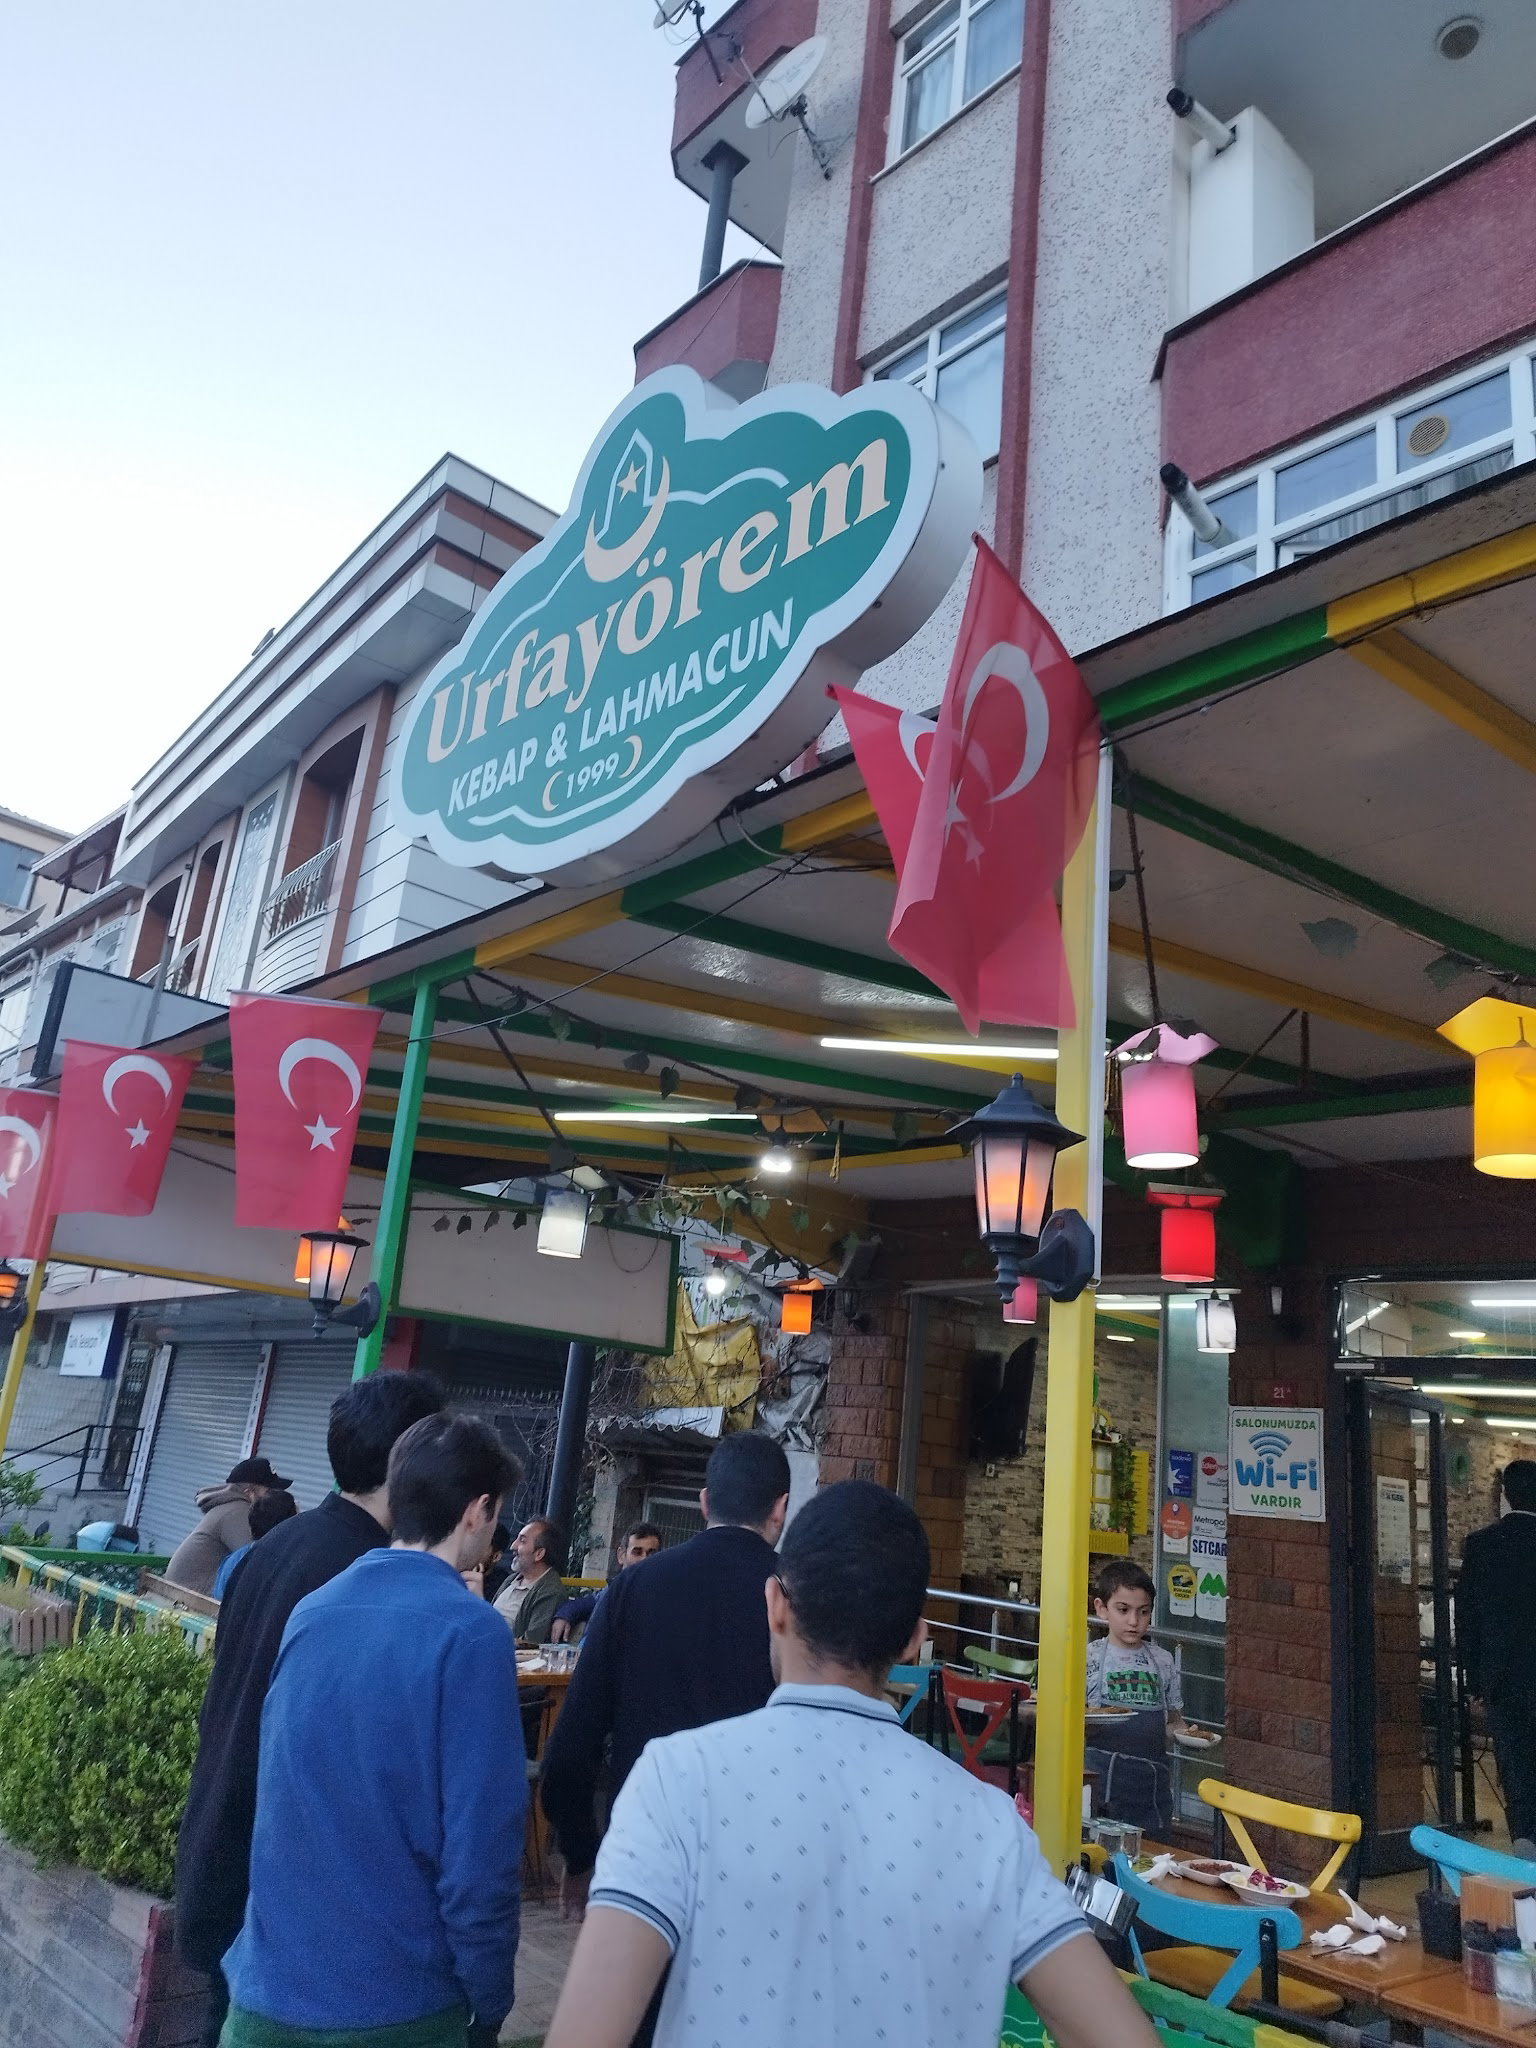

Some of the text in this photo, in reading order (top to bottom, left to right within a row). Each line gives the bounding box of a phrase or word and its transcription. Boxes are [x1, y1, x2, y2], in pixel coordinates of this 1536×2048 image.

[425, 437, 891, 763] Urfayörem
[447, 597, 794, 817] KEBAP & LAHMACUN
[566, 752, 620, 799] 1999
[1273, 1387, 1285, 1399] 21
[1235, 1418, 1317, 1430] SALONUMUZDA
[1234, 1455, 1318, 1491] Wi-Fi
[1250, 1493, 1302, 1509] VARDIR
[1194, 1514, 1226, 1527] Metropol
